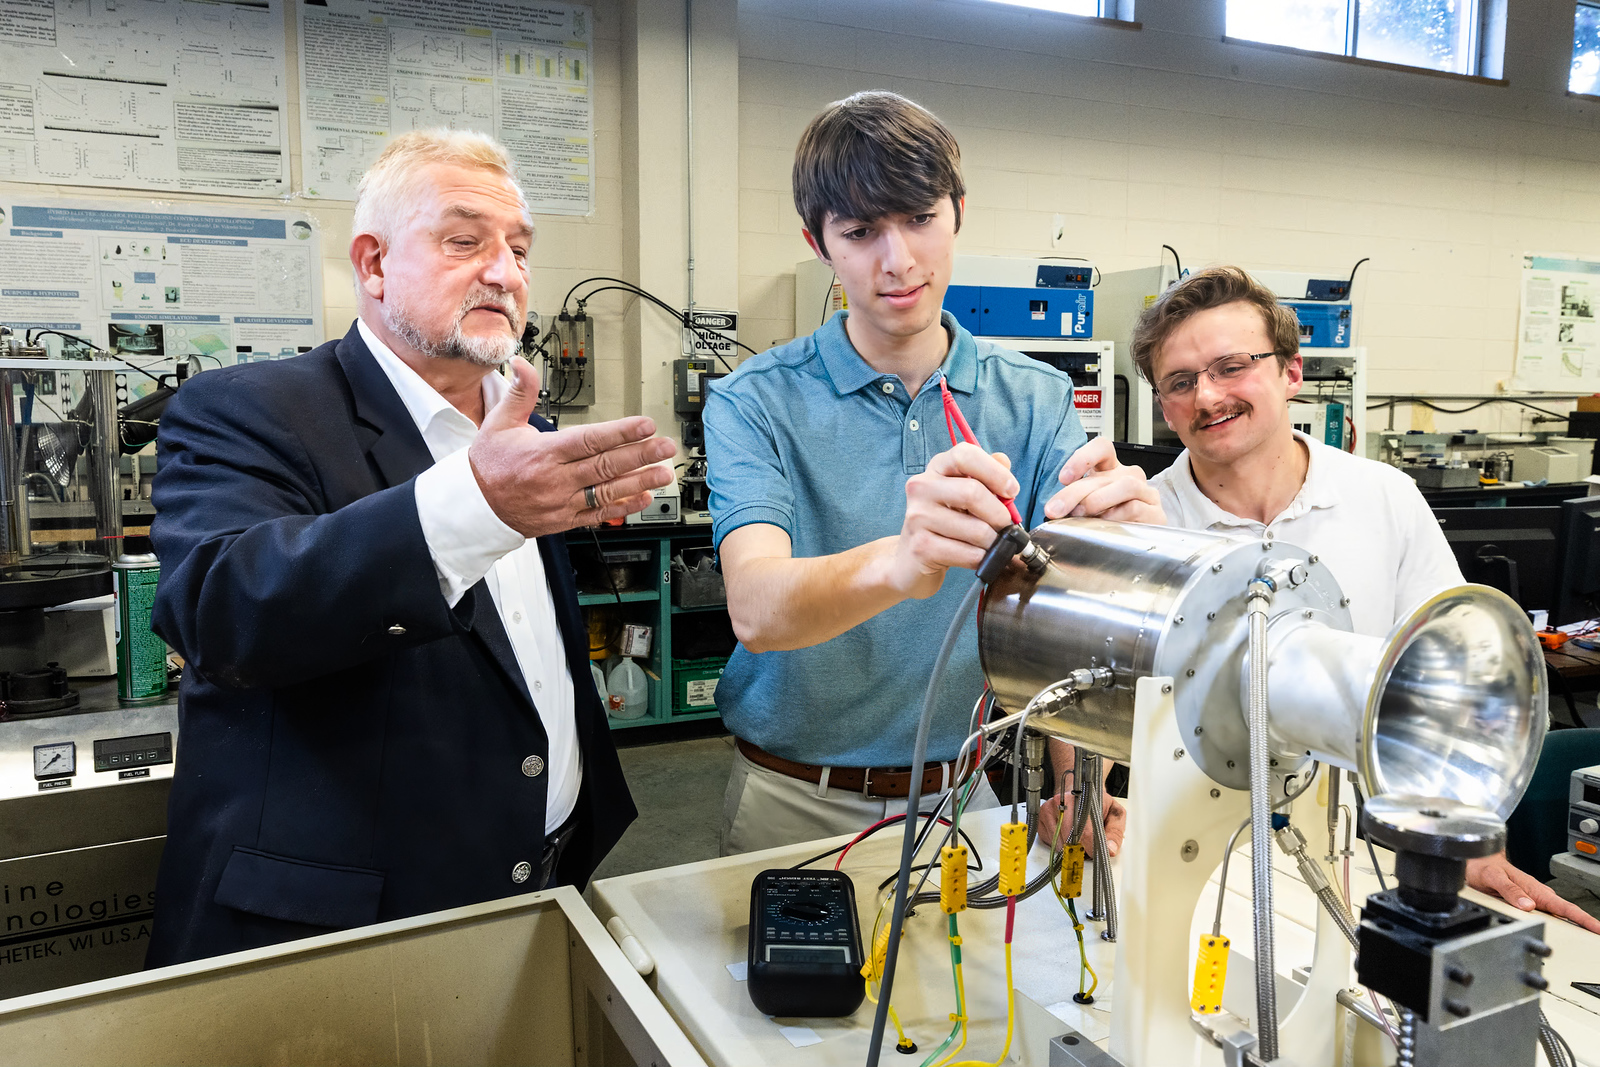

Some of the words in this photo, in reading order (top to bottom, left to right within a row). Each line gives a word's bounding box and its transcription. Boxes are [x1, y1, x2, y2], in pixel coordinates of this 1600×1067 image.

[1074, 294, 1086, 334] Purair
[695, 316, 726, 326] DANGER
[699, 332, 722, 340] HIGH
[690, 341, 731, 350] OLTAGE
[1073, 394, 1099, 403] ANGER
[664, 571, 670, 582] 3
[4, 881, 64, 904] ine
[6, 891, 156, 931] nologies
[0, 940, 62, 966] HETEK,
[69, 934, 93, 952] WI
